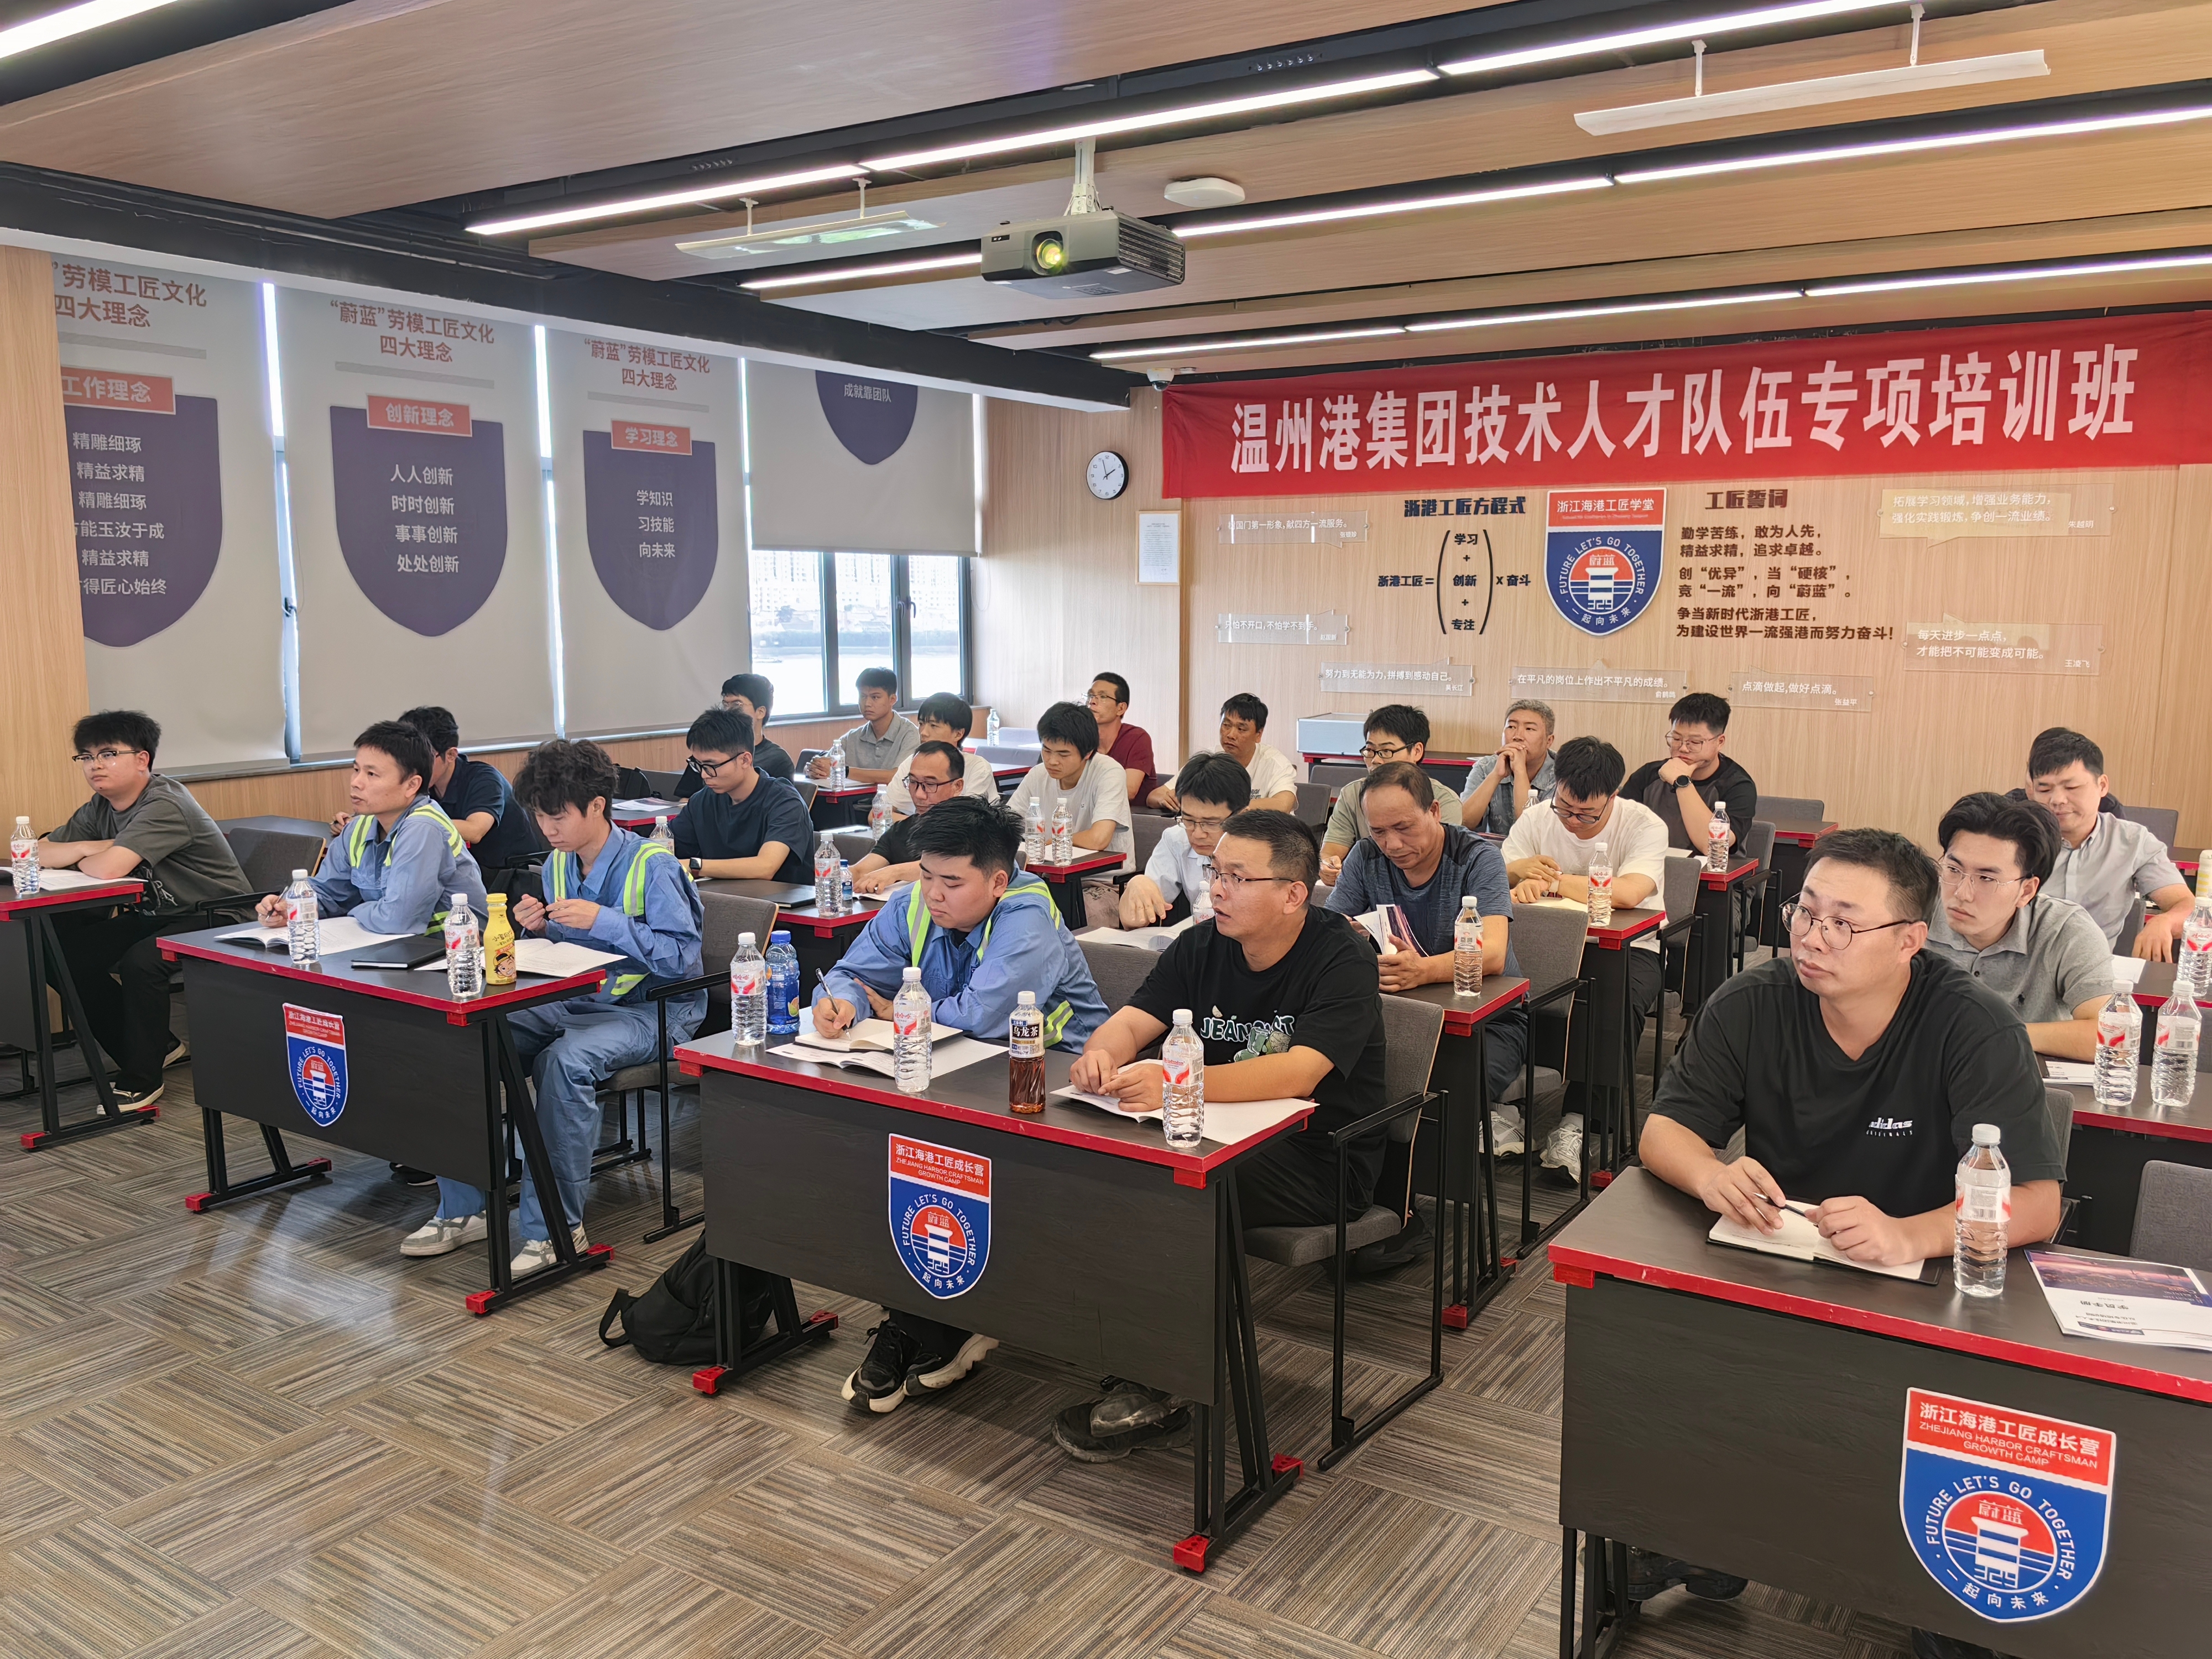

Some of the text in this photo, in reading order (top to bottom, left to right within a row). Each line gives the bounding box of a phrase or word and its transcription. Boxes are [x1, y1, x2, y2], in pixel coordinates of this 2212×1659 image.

[54, 295, 151, 327] 四大理念
[330, 300, 494, 344] “蔚蓝”劳模工匠文化
[380, 335, 452, 362] 四大理念
[584, 338, 710, 374] “蔚蓝”劳模工匠文化
[622, 368, 677, 390] 四大理念
[61, 376, 152, 403] 工作理念
[844, 383, 891, 403] 成就靠团队
[385, 403, 454, 427] 创新理念
[1231, 344, 2138, 473] 温州港集团技术人才队伍专项培训班
[72, 432, 142, 453] 精雕细琢
[625, 427, 678, 447] 学习理念
[76, 462, 145, 482] 精益求精
[390, 464, 453, 486] 人人创新
[78, 491, 147, 510] 精雕细琢
[392, 495, 455, 515] 时时创新
[637, 490, 673, 507] 学知识
[1404, 496, 1526, 517] 浙港工匠方程式
[1557, 497, 1654, 513] 浙江海港工匠学堂
[1705, 489, 1788, 509] 工匠誓词
[395, 524, 458, 544] 事事创新
[638, 516, 674, 533] 习技能
[1454, 533, 1478, 545] 学习
[82, 549, 149, 567] 精益求精
[639, 542, 675, 558] 向未来
[397, 554, 460, 573] 处处创新
[1559, 536, 1646, 594] FUTURE LET'S GO TOGETHER
[80, 578, 167, 594] 得匠心始终
[1453, 575, 1477, 586] 创新
[1506, 574, 1531, 586] 奋斗
[1451, 619, 1475, 630] 专注
[1572, 607, 1631, 625] 一起向未来
[1677, 607, 1817, 622] 争当新时代浙港工匠，
[1676, 625, 1893, 640] 为建设世界一流强港而努力奋斗！
[1917, 629, 2007, 641] 每天进步一点点，
[1917, 646, 2044, 659] 才能把不可能变成可能。
[1517, 674, 1668, 688] 在平凡的岗位上作出不平凡的成绩。
[1742, 681, 1837, 695] 点滴做起，做好点滴。
[1013, 1026, 1039, 1037] 乌龙茶
[896, 1144, 984, 1177] 浙江海港工匠成长营
[901, 1194, 976, 1265] FUTURE LET'S GO TOGETHER
[914, 1263, 964, 1289] 一起向未来
[1920, 1401, 2099, 1457] 浙江海港工匠成长营
[1919, 1421, 2098, 1469] ZHEJIANG HARBOR CRAFTSMAN
[1963, 1441, 2049, 1466] GROWTH CAMP
[1979, 1499, 2023, 1526] 蔚蓝
[1926, 1475, 2075, 1580] FUTURE LET'S GO TOGETHER
[1947, 1568, 2049, 1610] 一起向未来
